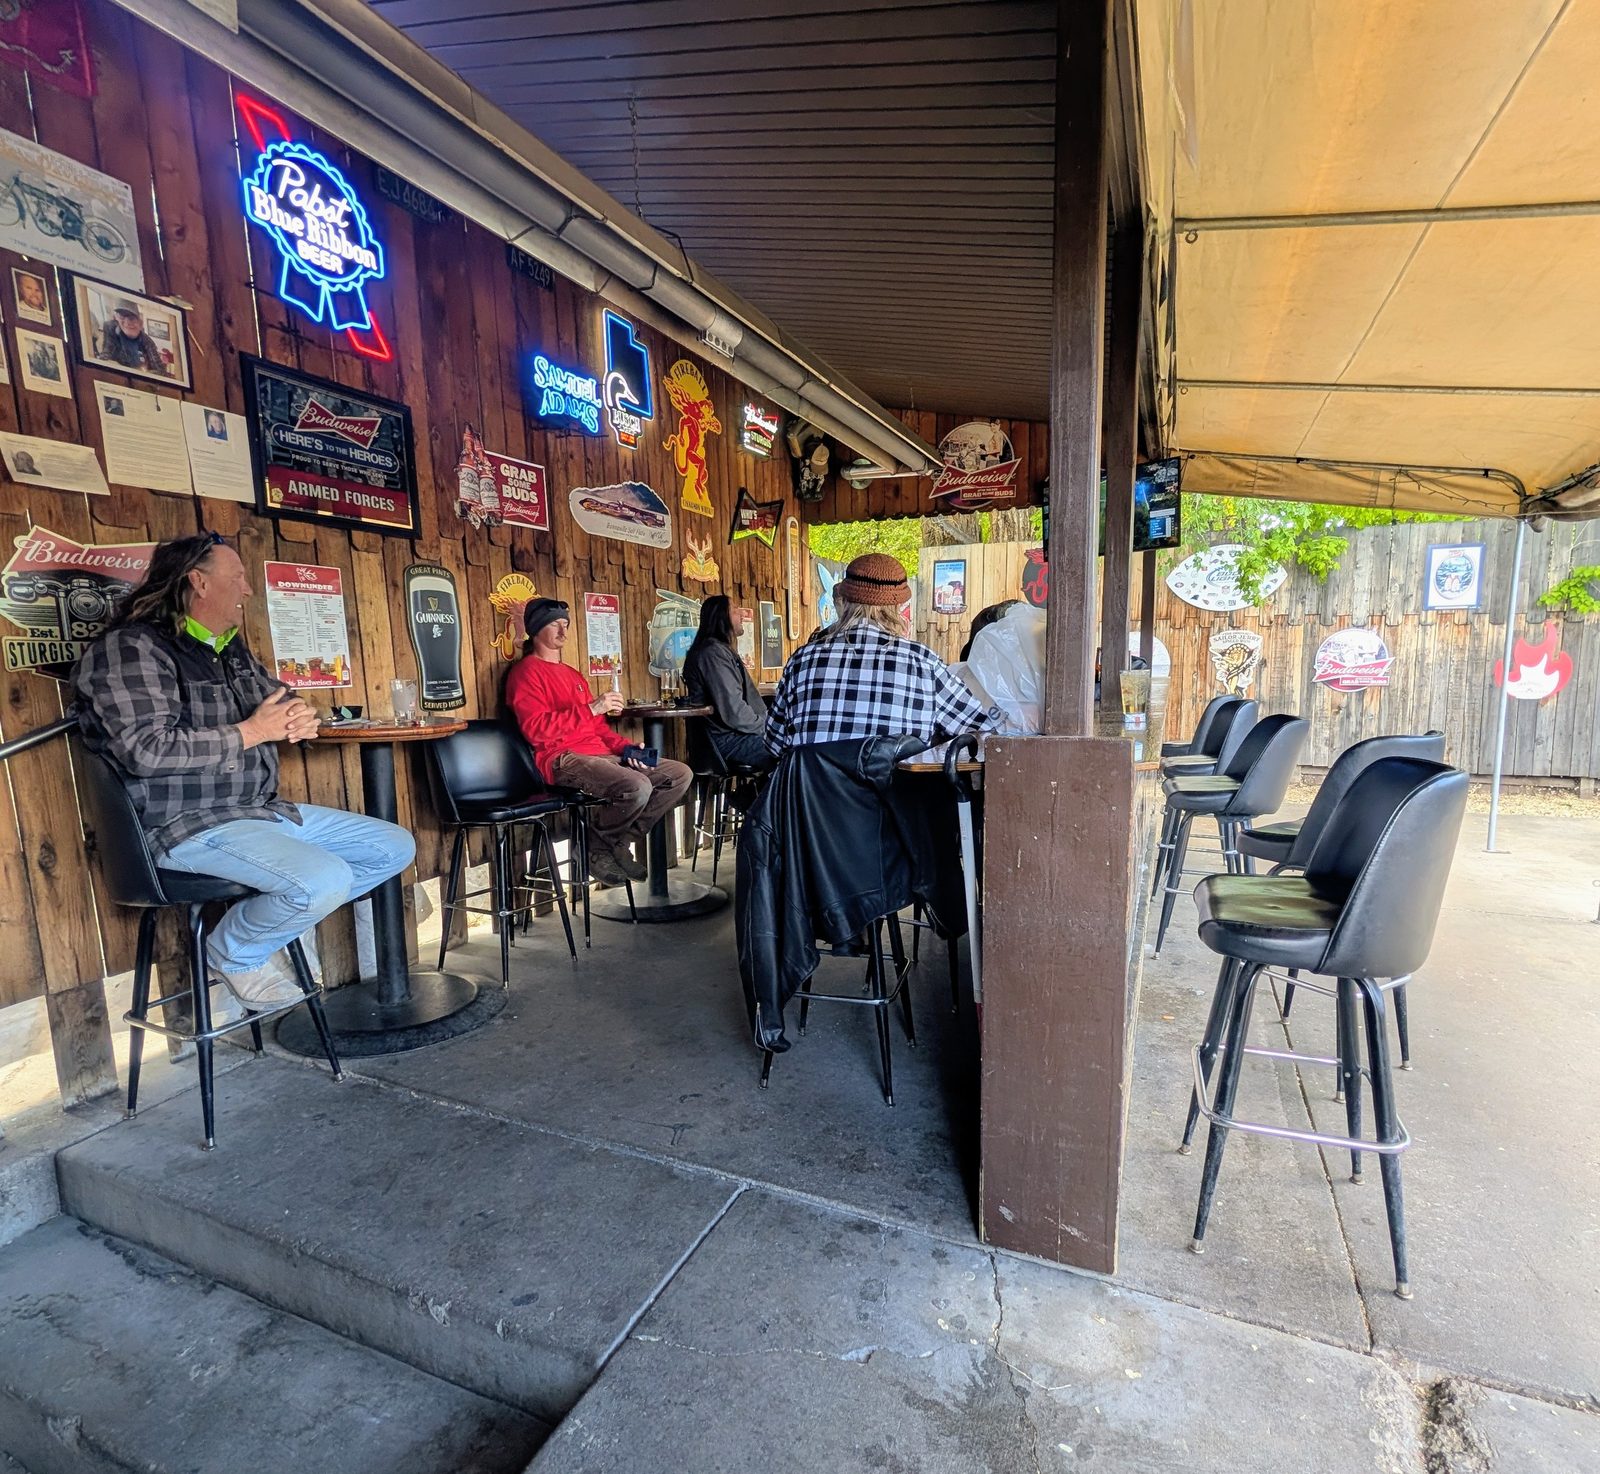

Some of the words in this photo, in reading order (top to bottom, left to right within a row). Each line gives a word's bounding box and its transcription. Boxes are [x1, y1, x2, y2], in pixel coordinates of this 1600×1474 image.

[272, 159, 352, 228] Pabst
[251, 185, 304, 236] Blue
[304, 212, 377, 270] Ribbon
[297, 239, 343, 274] BEER
[673, 362, 706, 392] FIREBALL
[293, 402, 379, 438] Budweiser
[280, 431, 323, 451] HERE'S
[349, 448, 393, 468] HEROES
[291, 454, 311, 463] PROUD
[322, 461, 339, 469] SERVE
[341, 465, 357, 473] THOSE
[500, 463, 537, 483] GRAB
[508, 477, 532, 490] SOME
[931, 470, 1016, 488] Budweiser
[288, 480, 339, 501] ARMED
[345, 490, 395, 512] FORCES
[502, 485, 538, 504] BUDS
[502, 502, 539, 517] Budweiser
[410, 566, 431, 575] GREAT
[432, 567, 450, 578] PINTS
[278, 581, 333, 590] DOWNUNDER
[500, 575, 534, 593] FIREBALL
[416, 612, 454, 624] GUINNESS
[29, 628, 58, 638] Est.
[8, 641, 75, 667] STURGIS
[1314, 662, 1390, 675] Budweiser
[424, 701, 448, 709] SERVED
